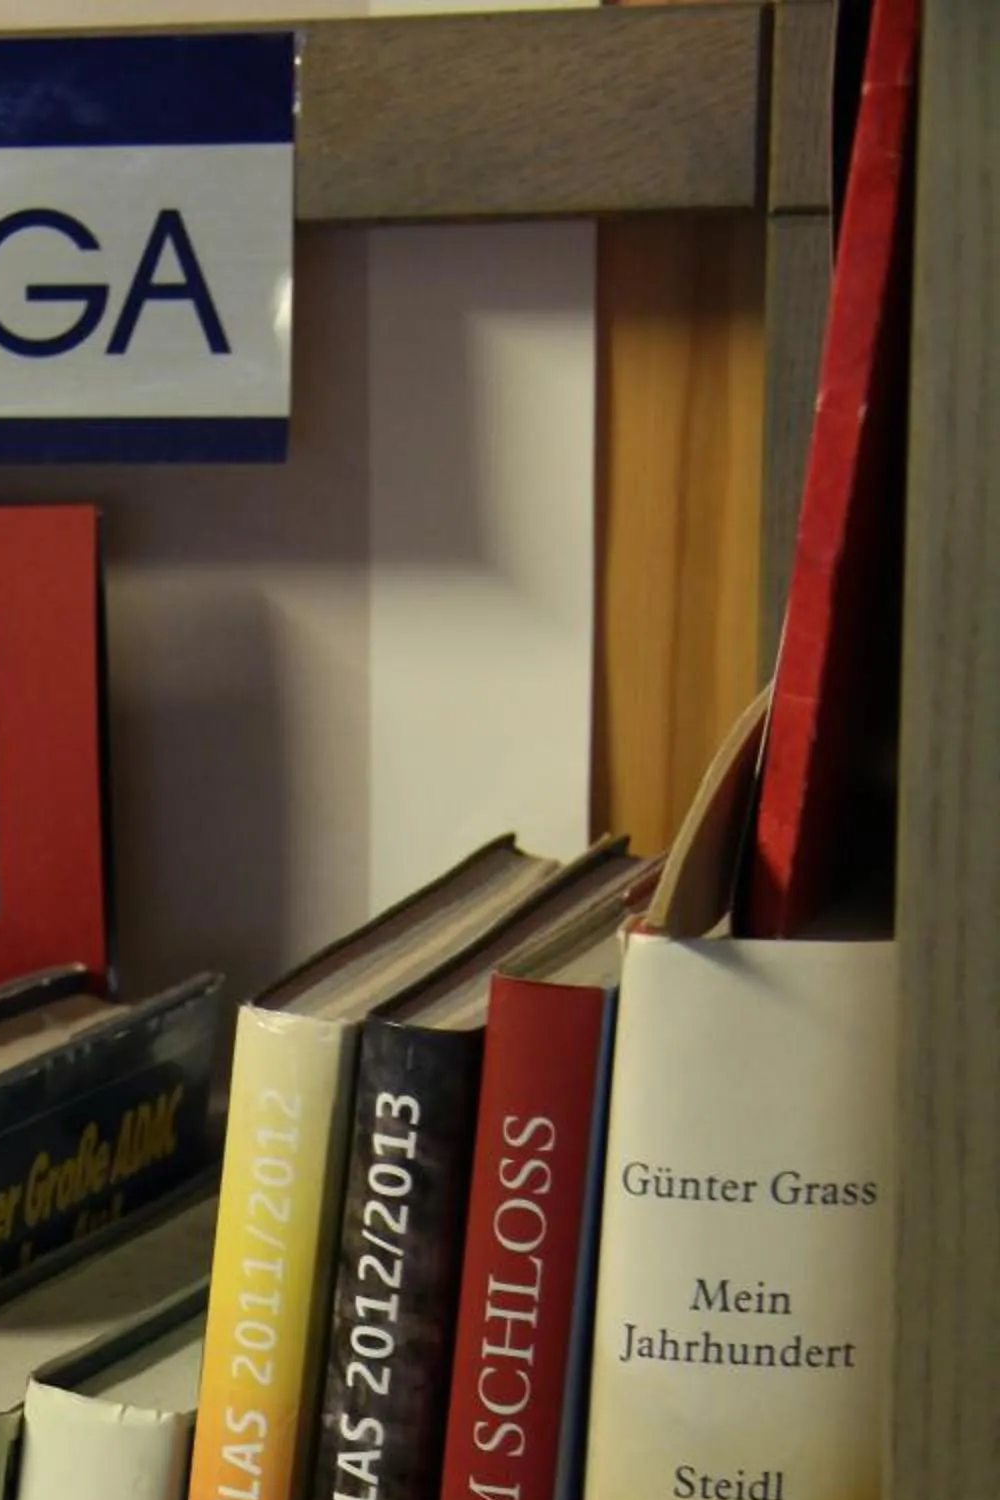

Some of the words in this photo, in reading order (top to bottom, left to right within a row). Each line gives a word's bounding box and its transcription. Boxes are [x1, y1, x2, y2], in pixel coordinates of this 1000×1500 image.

[232, 1089, 301, 1386] 2011/2012
[350, 1093, 420, 1396] 2012/2013
[622, 1162, 758, 1203] Günter
[770, 1170, 877, 1206] Grass
[476, 1116, 555, 1457] SCHLOSS
[619, 1323, 856, 1368] Jahrhundert
[689, 1278, 792, 1315] Mein
